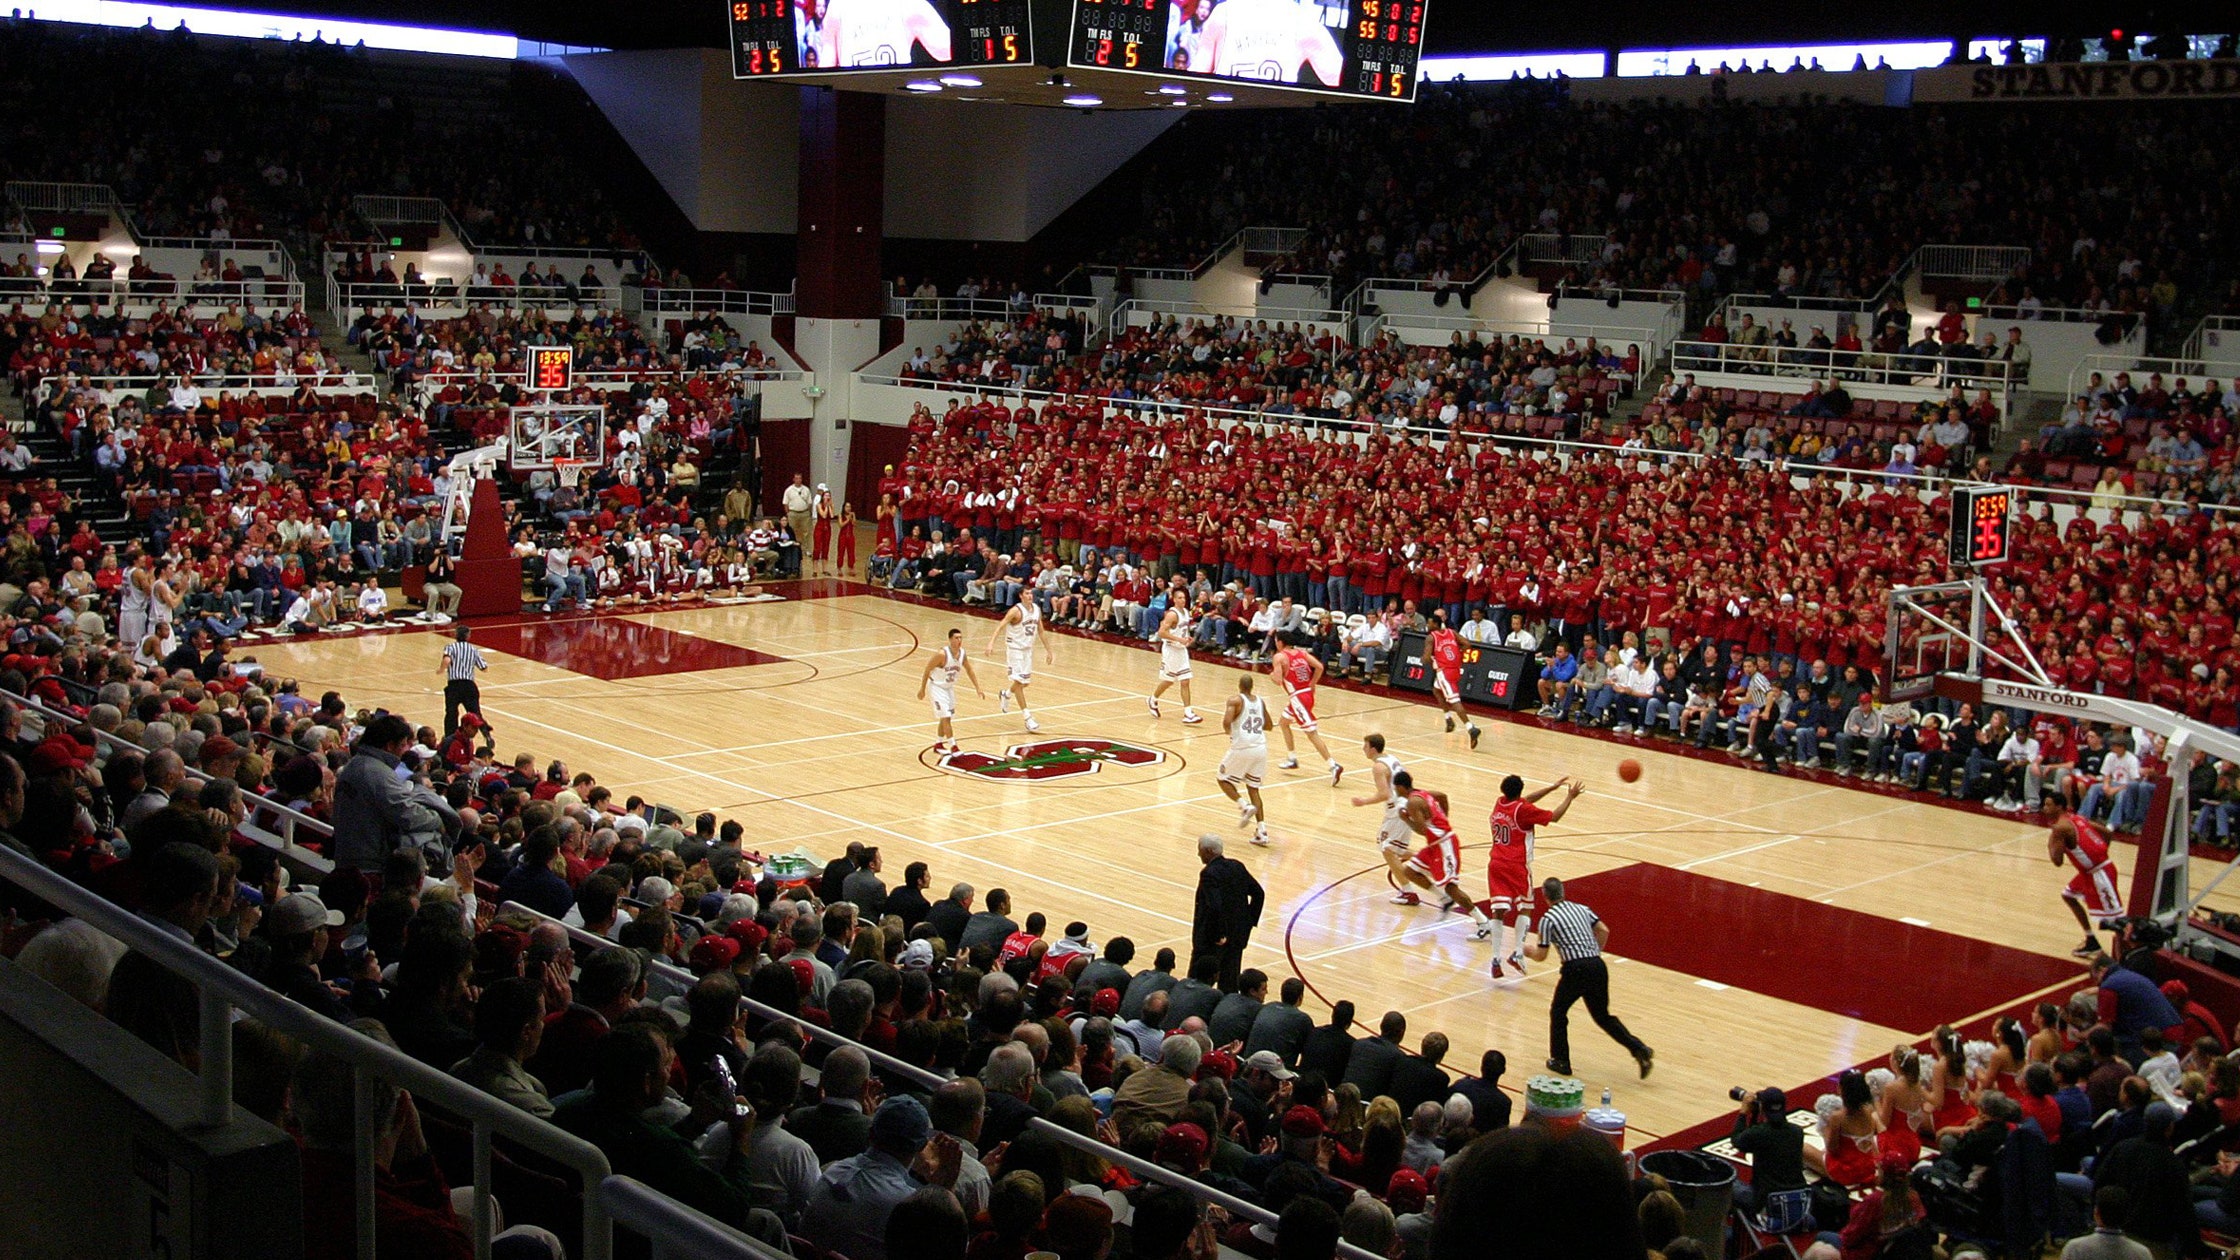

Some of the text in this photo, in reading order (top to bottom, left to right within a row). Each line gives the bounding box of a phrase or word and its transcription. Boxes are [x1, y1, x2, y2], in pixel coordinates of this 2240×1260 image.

[1359, 20, 1377, 39] 55
[1004, 36, 1017, 61] 5
[1096, 40, 1113, 65] 2
[1125, 43, 1138, 67] 5
[750, 49, 763, 73] 2
[769, 49, 782, 73] 5
[1390, 74, 1402, 96] 5
[1972, 63, 2240, 98] STANFORD
[539, 351, 569, 364] 13:59
[539, 365, 564, 386] 35
[1975, 495, 2007, 518] 13:59
[1974, 519, 2002, 559] 35
[1488, 670, 1509, 680] GUEST
[1996, 684, 2089, 708] STANFORD
[1242, 716, 1263, 735] 42
[1493, 823, 1510, 846] 20
